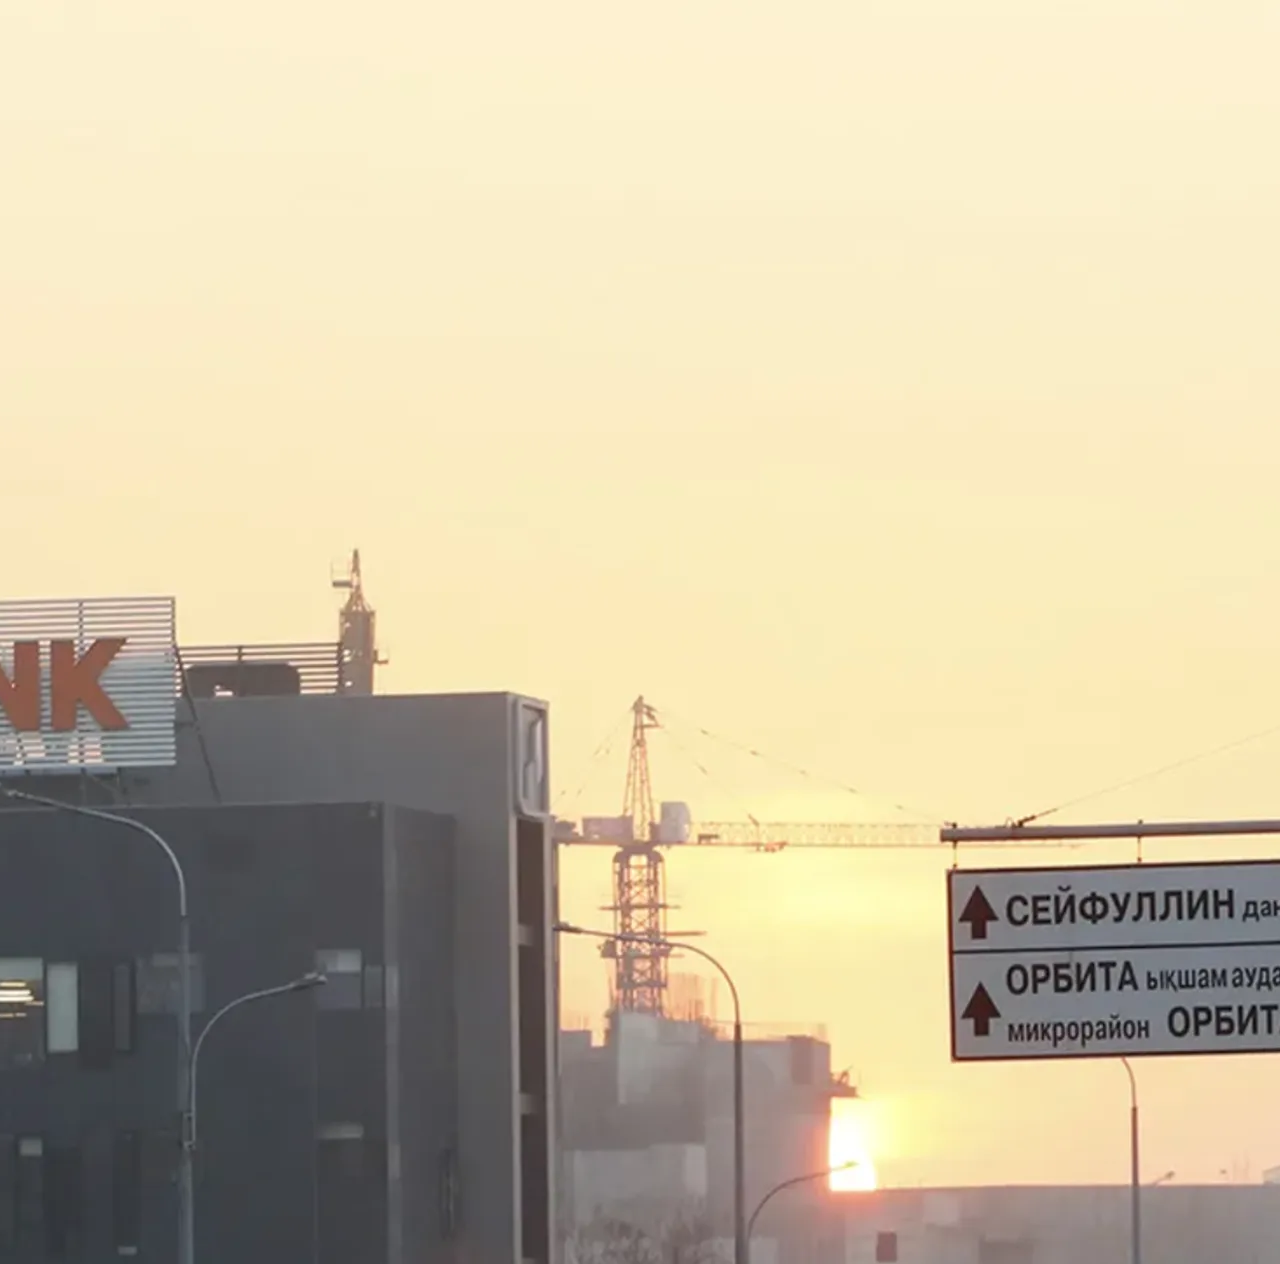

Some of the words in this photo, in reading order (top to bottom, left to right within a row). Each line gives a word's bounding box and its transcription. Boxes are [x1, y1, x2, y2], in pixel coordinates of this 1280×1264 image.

[1006, 886, 1235, 926] СЕЙФУЛЛИН
[1006, 960, 1138, 995] ОРБИТА
[1147, 966, 1227, 994] ықшам
[1008, 1014, 1149, 1047] микрорайон
